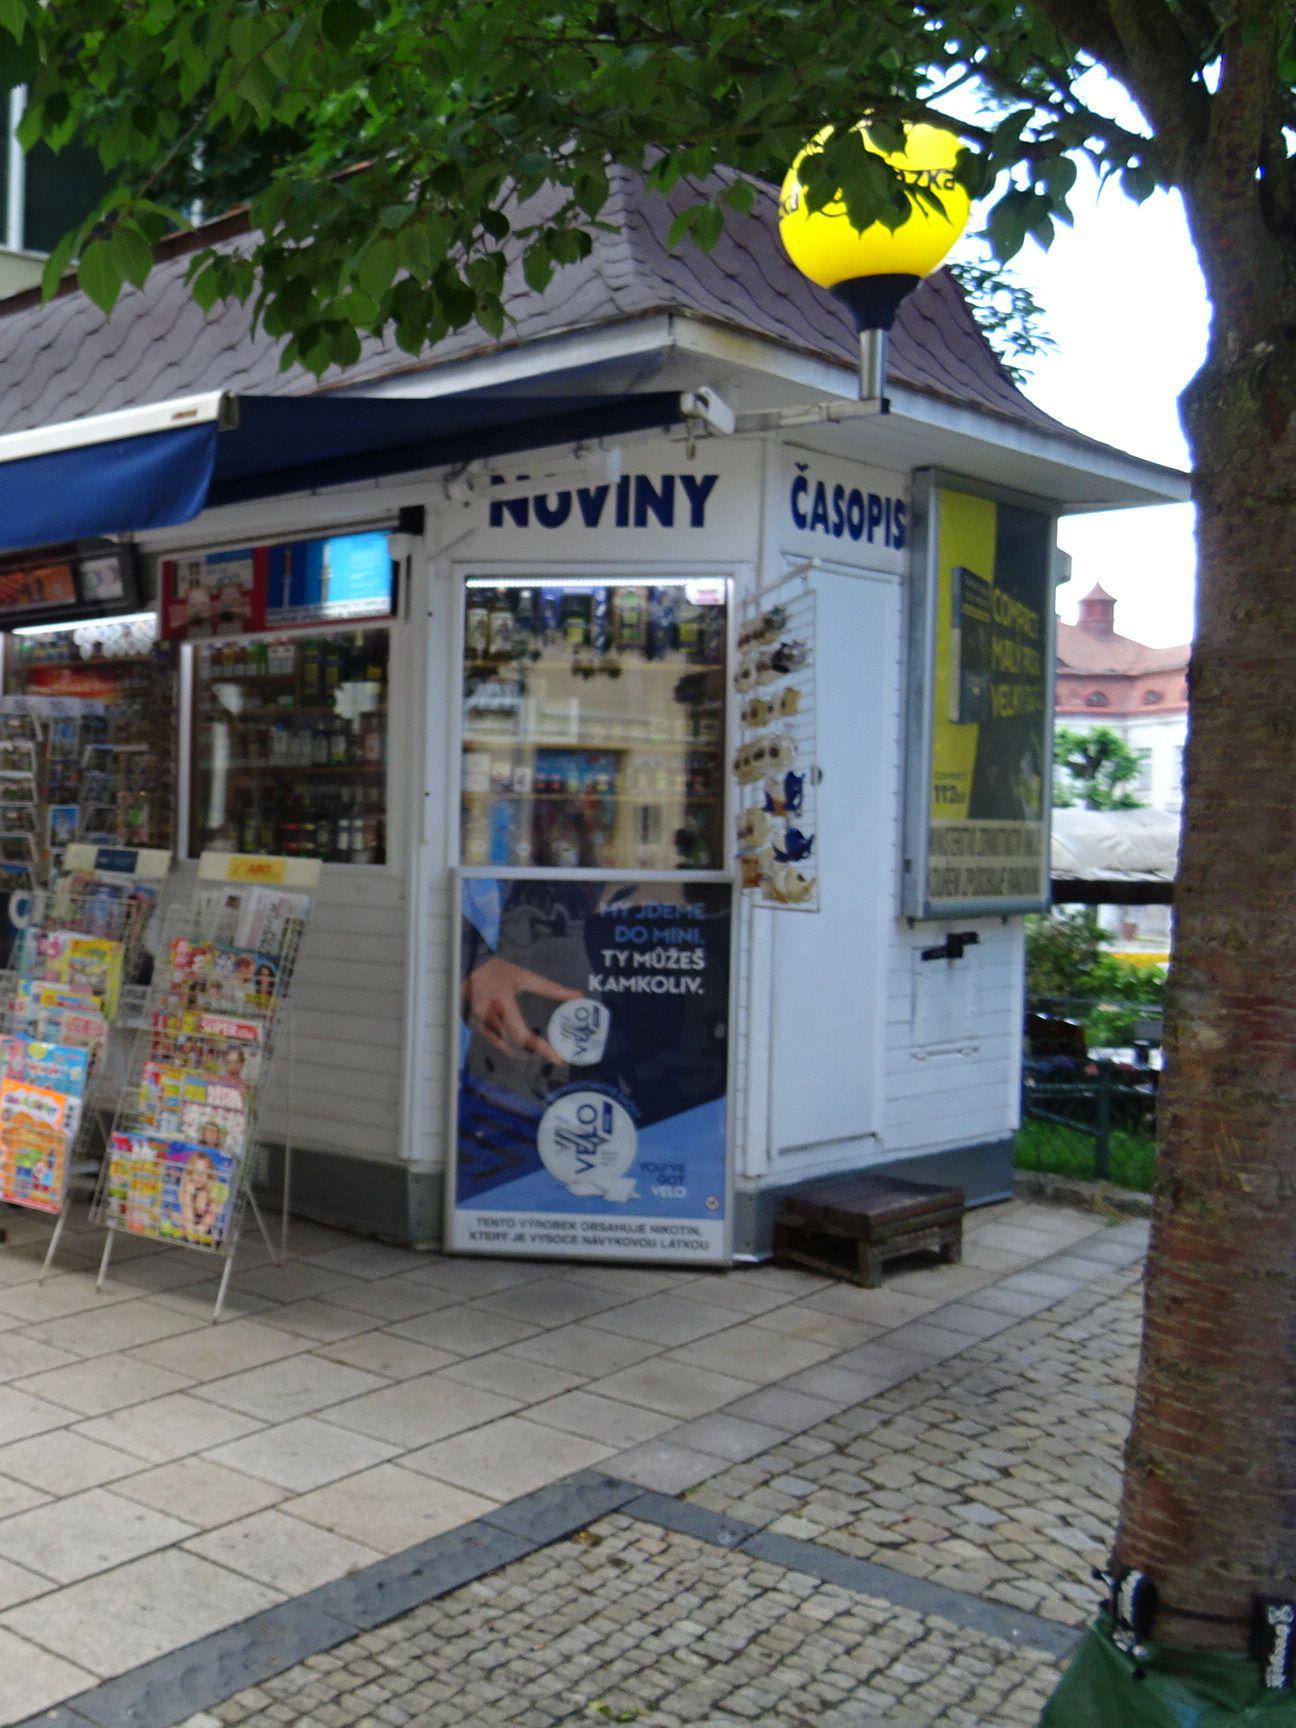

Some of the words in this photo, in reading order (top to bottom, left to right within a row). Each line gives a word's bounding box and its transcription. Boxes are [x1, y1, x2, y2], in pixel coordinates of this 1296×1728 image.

[489, 474, 720, 529] NOVINY
[790, 461, 907, 550] ČASOPIS
[613, 925, 649, 944] DO
[601, 949, 630, 968] TY
[588, 974, 705, 994] KAMKOLIV.
[576, 1104, 598, 1175] VELO
